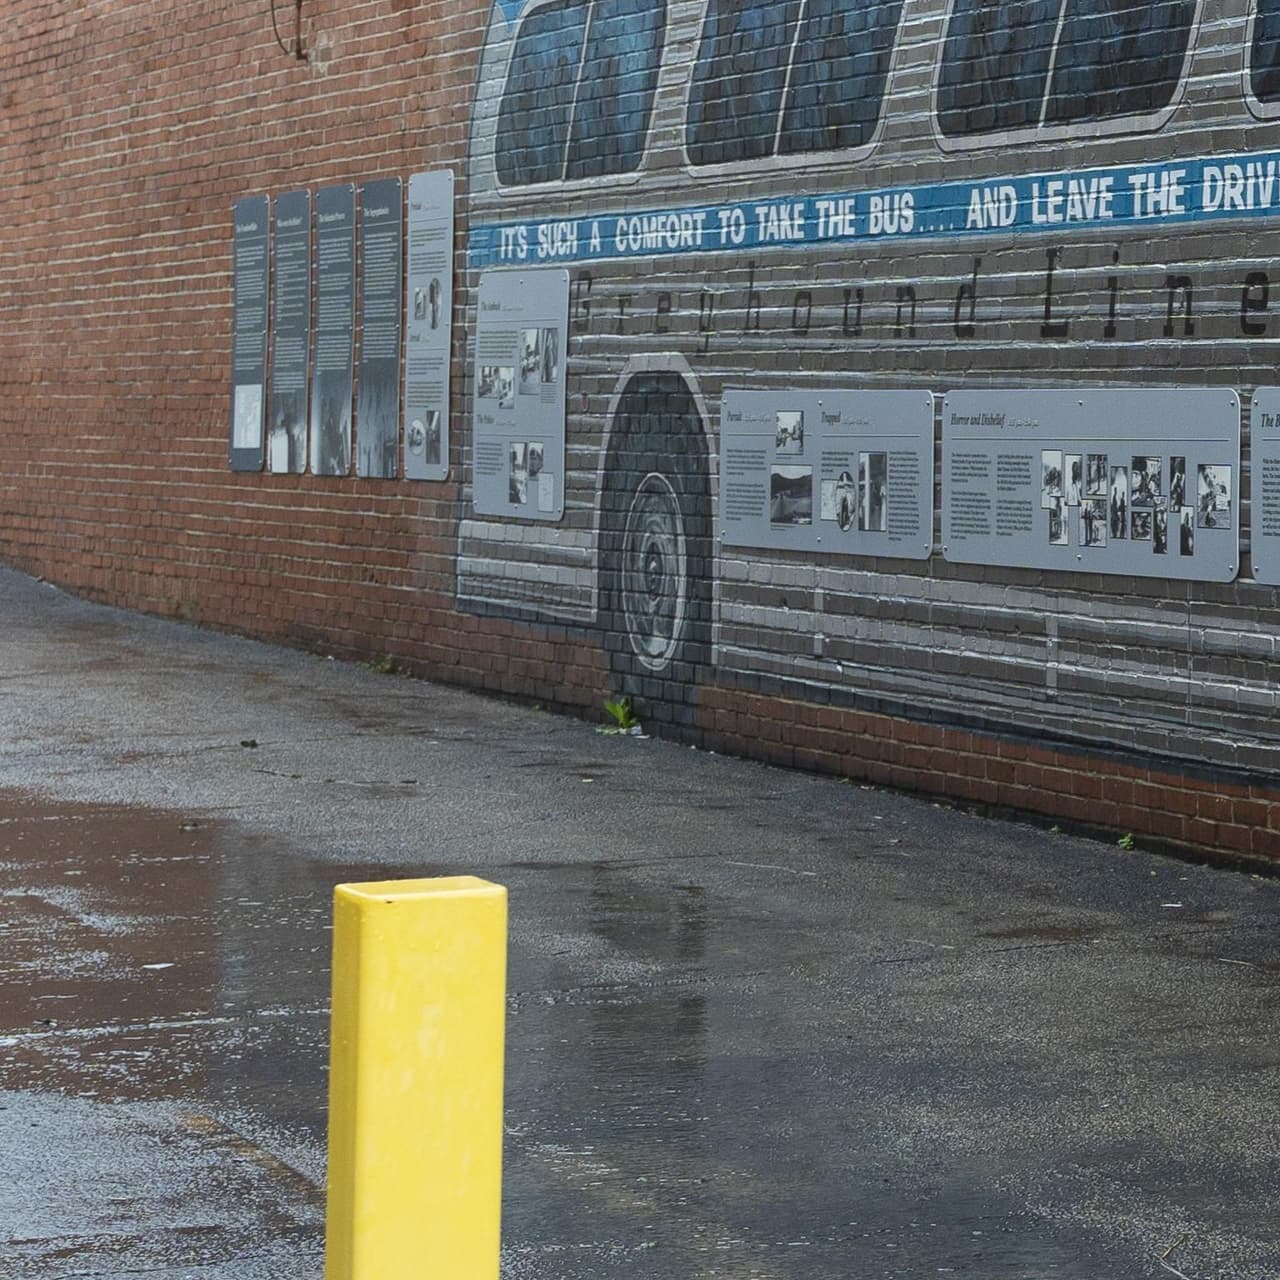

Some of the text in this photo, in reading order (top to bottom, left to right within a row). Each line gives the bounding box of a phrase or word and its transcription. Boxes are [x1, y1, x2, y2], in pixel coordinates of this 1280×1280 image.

[500, 226, 527, 259] IT'S
[537, 222, 578, 258] SUCH
[590, 222, 601, 252] A
[616, 212, 706, 252] COMFORT
[719, 208, 746, 243] TO
[756, 203, 805, 240] TAKE
[815, 197, 856, 235] THE
[966, 185, 1017, 229] AND
[1032, 177, 1113, 223] LEAVE
[1128, 169, 1186, 217] THE
[572, 258, 982, 354] Greyhound
[950, 413, 969, 425] Horror
[970, 413, 981, 425] and
[981, 413, 1005, 426] Disbelief
[1261, 413, 1274, 427] The
